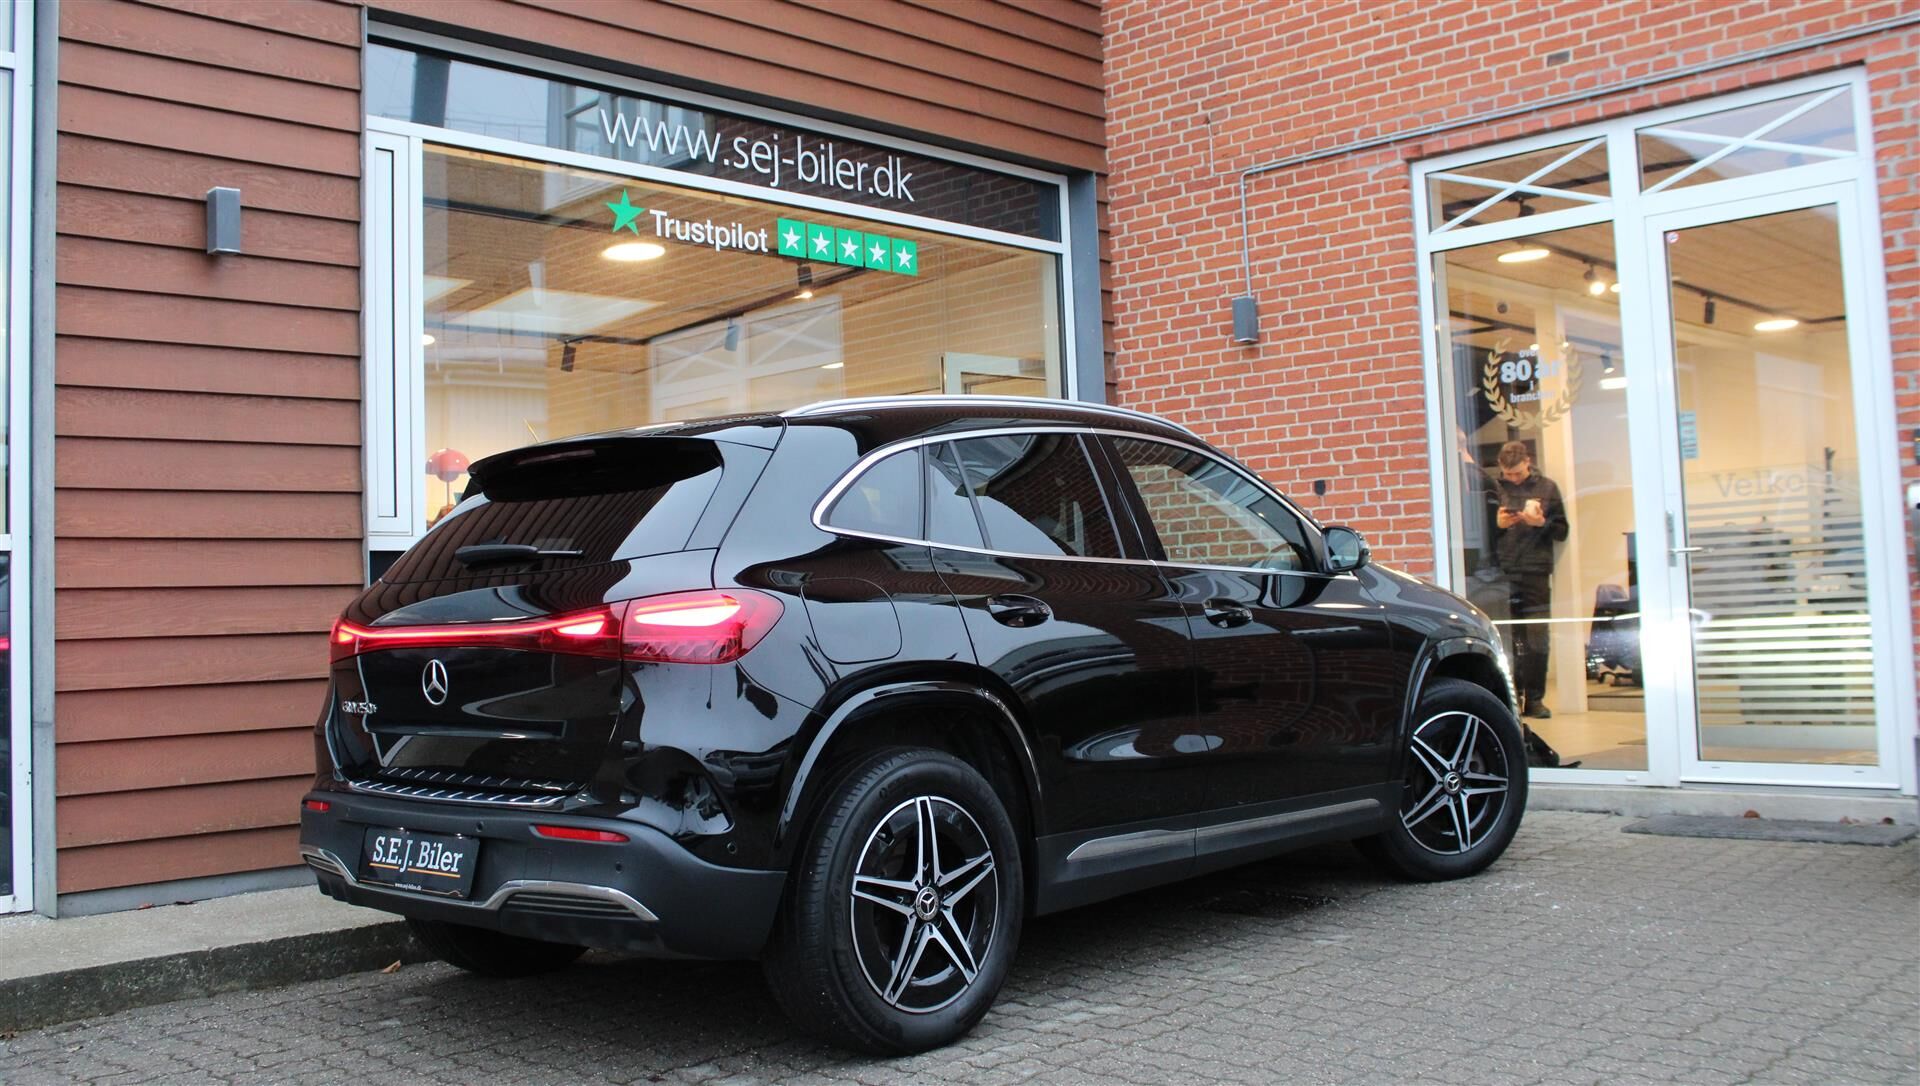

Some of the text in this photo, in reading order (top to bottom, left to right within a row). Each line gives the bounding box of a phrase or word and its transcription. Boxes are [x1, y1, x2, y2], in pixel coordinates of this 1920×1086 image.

[600, 108, 915, 202] www.sej-biler.dk
[649, 209, 768, 253] Trustpilot
[1501, 360, 1531, 382] 80
[1713, 470, 1802, 497] Velko
[372, 836, 463, 872] S.E.J. Biler
